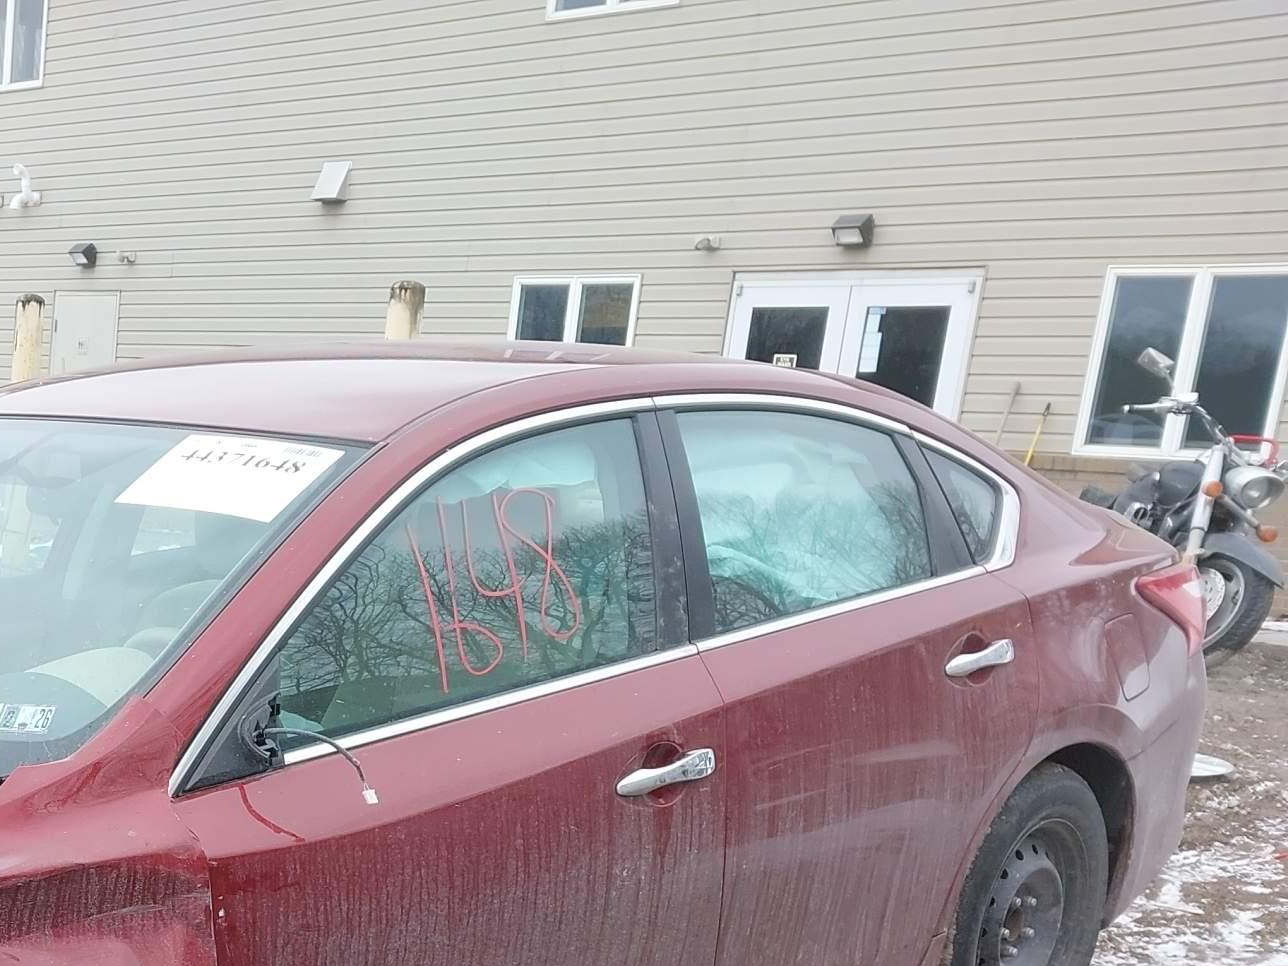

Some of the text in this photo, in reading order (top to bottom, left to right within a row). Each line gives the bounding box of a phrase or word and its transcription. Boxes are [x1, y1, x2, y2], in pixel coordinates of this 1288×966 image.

[180, 447, 308, 475] 44371648
[405, 487, 580, 694] 1648
[34, 708, 53, 729] 26
